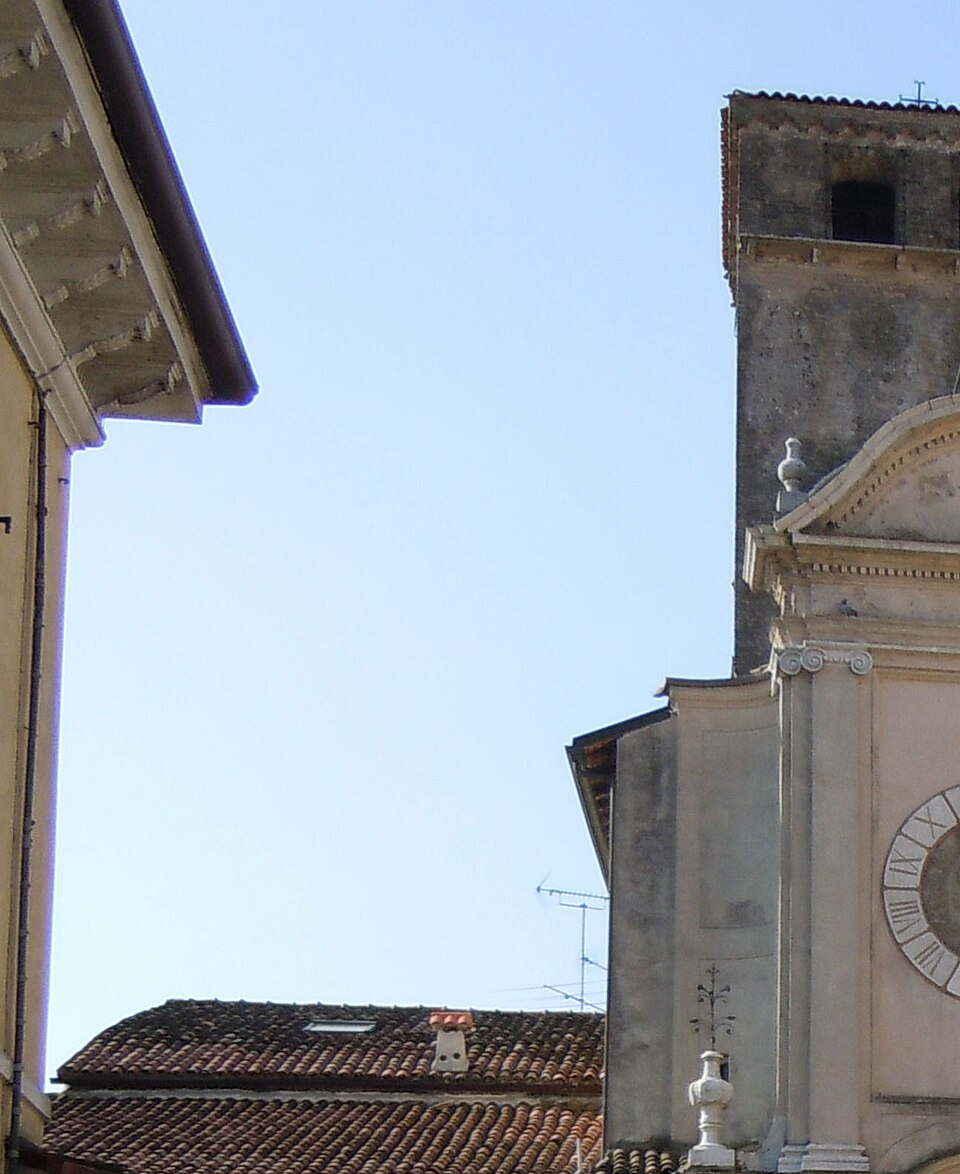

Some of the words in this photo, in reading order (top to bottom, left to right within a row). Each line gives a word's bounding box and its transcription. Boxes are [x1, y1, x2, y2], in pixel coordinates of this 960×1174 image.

[914, 806, 947, 839] X
[888, 848, 922, 877] IX
[889, 899, 922, 935] VIII
[914, 941, 943, 976] VII
